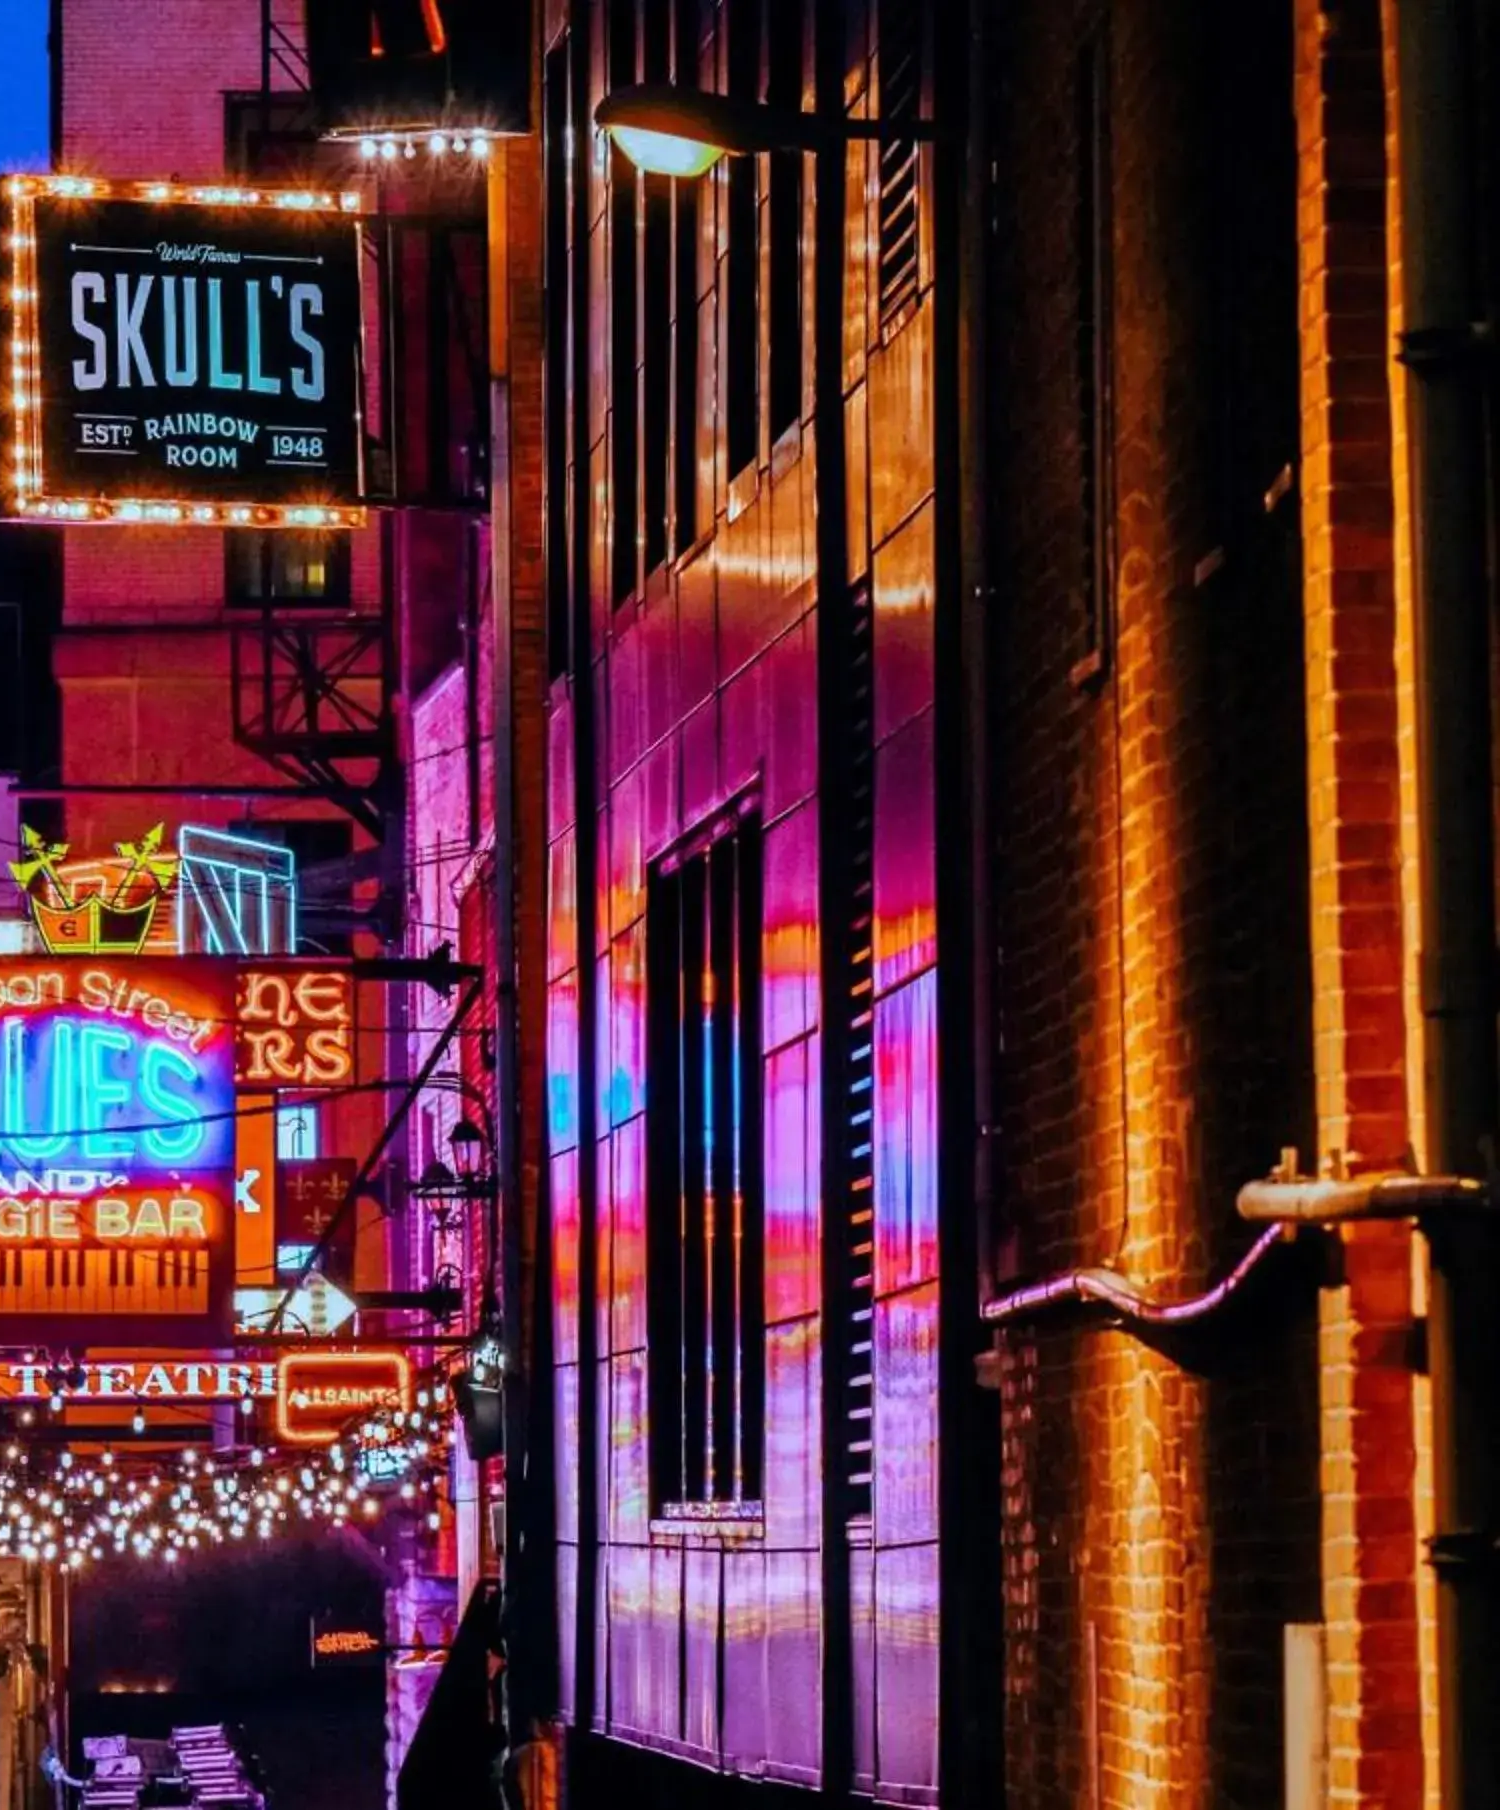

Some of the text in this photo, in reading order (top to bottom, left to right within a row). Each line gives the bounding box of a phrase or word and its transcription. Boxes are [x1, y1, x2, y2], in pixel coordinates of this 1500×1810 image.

[70, 271, 325, 402] SKULL'S
[144, 412, 260, 443] RAINBOW
[166, 444, 238, 468] ROOM
[272, 435, 324, 458] 1948
[79, 971, 216, 1053] Street
[95, 1199, 207, 1240] BAR
